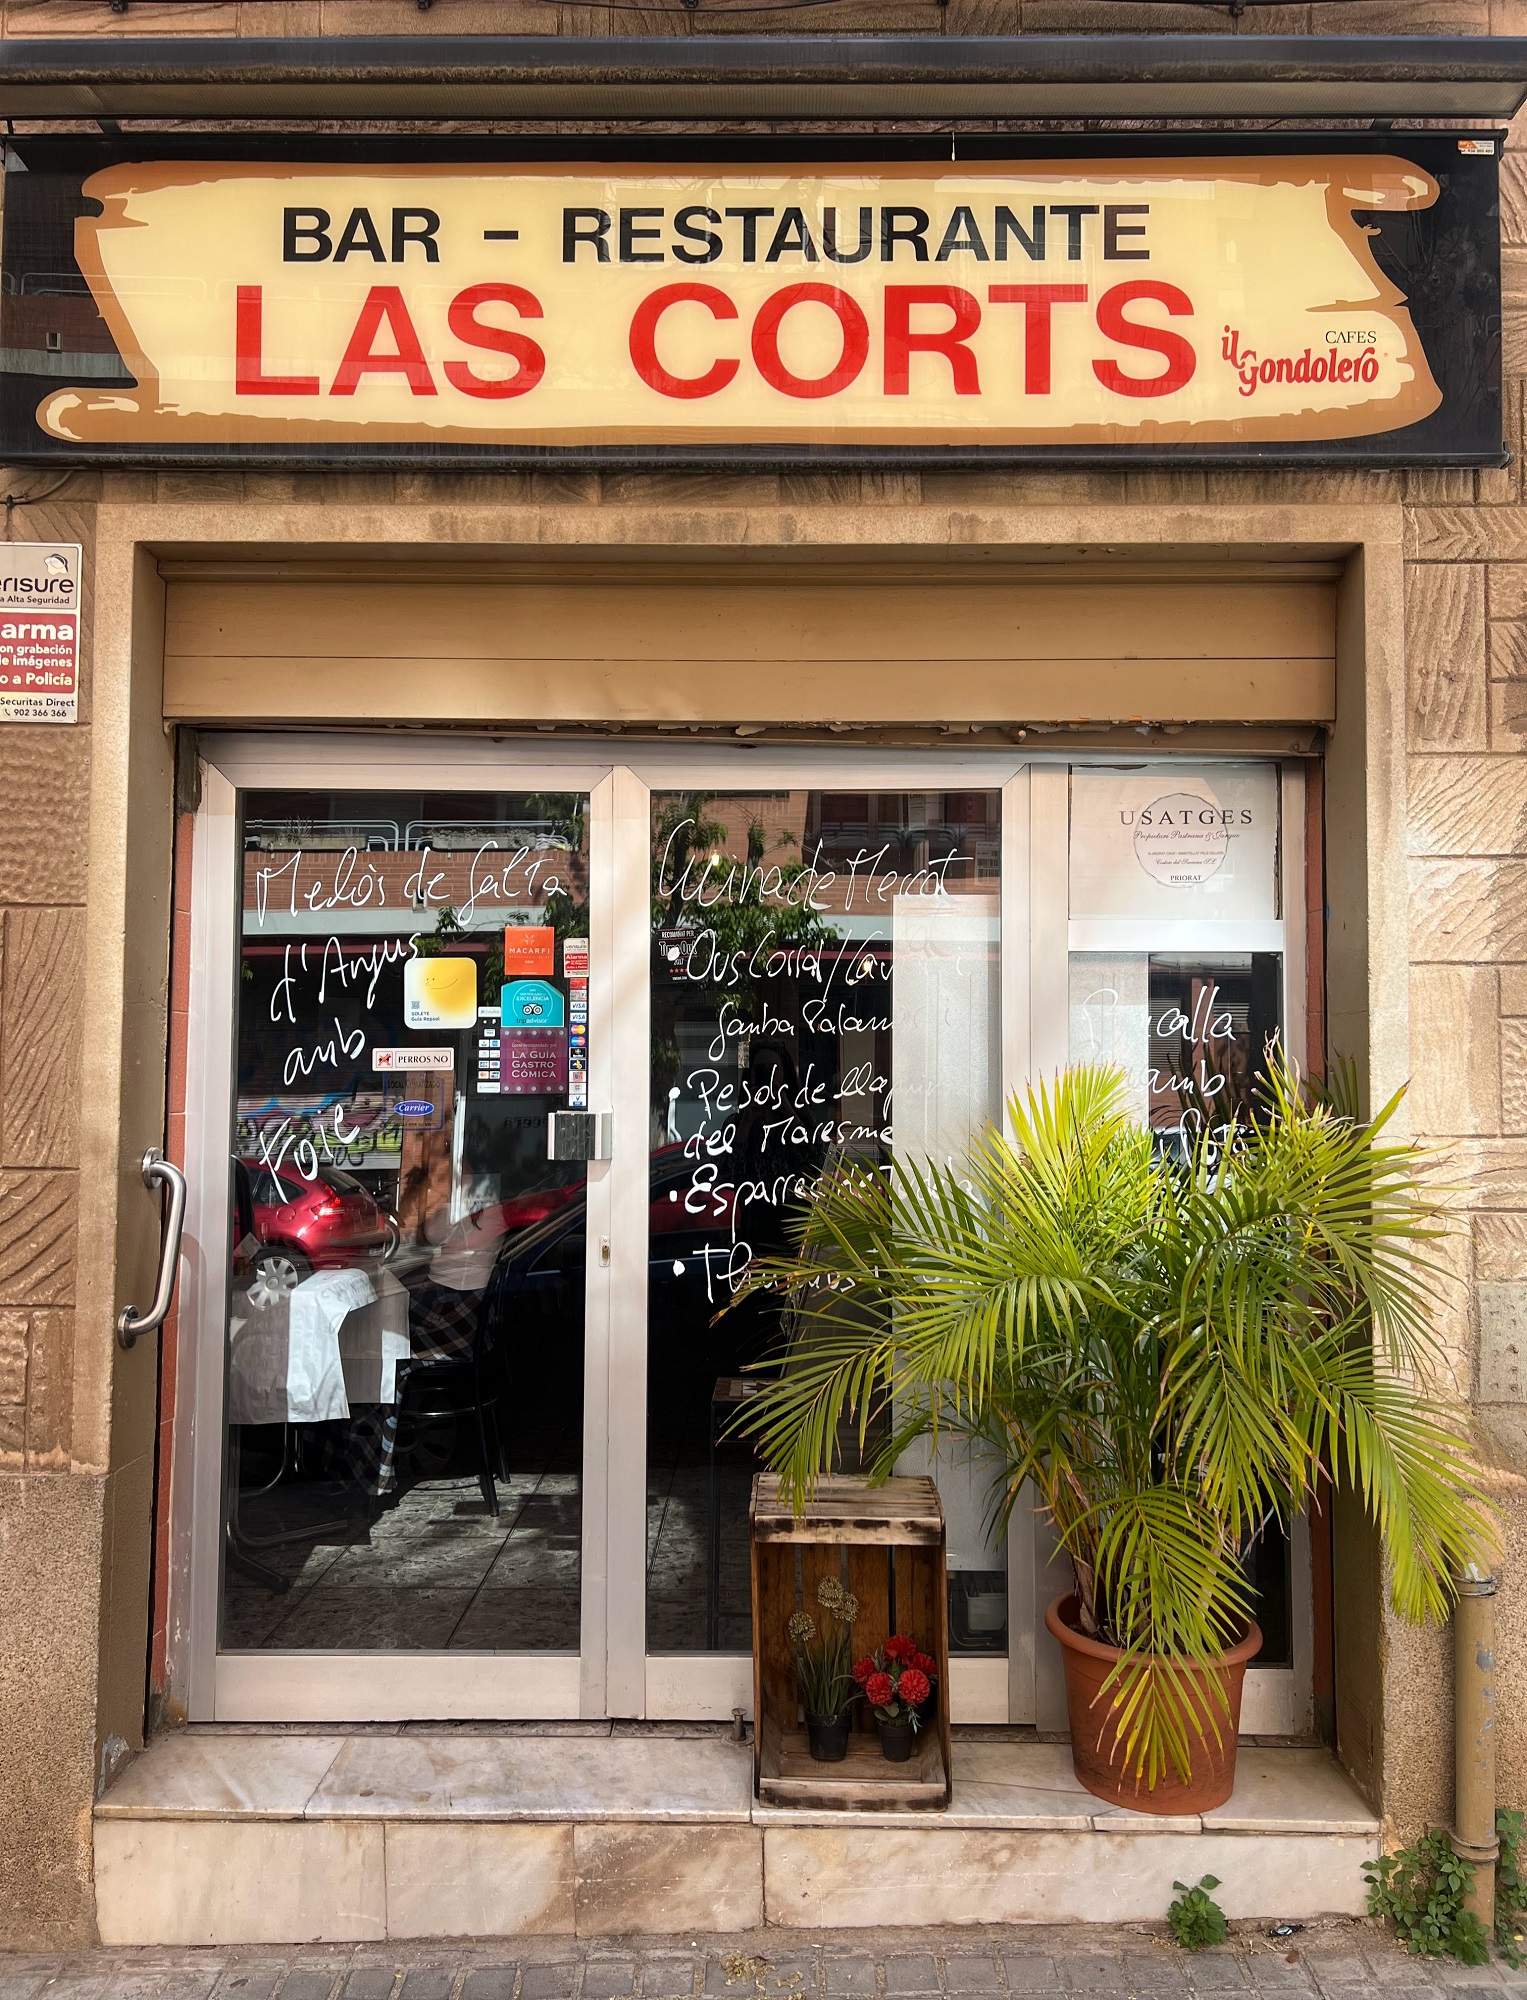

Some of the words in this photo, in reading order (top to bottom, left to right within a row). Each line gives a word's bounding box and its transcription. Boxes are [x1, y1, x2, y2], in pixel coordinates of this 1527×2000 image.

[282, 207, 441, 262] BAR
[562, 205, 1150, 264] RESTAURANTE
[235, 282, 546, 399] LAS
[628, 280, 1197, 399] CORTS
[1325, 330, 1377, 344] CAFES
[0, 577, 74, 593] risure
[8, 595, 24, 603] Alta
[27, 595, 70, 605] Seguridad
[17, 642, 72, 656] grabación
[12, 654, 73, 669] imágenes
[12, 674, 21, 684] a
[26, 671, 73, 686] Policía
[0, 696, 43, 706] Securitas
[46, 698, 75, 707] Direct
[14, 708, 29, 717] 902
[32, 709, 48, 717] 366
[1119, 809, 1253, 826] USATGES
[404, 846, 450, 900] de
[786, 837, 836, 911] de
[398, 1055, 431, 1063] PERROS
[433, 1055, 449, 1063] NO
[511, 1050, 526, 1059] LA
[511, 1060, 557, 1068] GASTRO-
[511, 1069, 557, 1078] CÓMICA
[794, 1063, 827, 1108] de
[398, 1103, 430, 1112] Carrier
[684, 1120, 736, 1161] del
